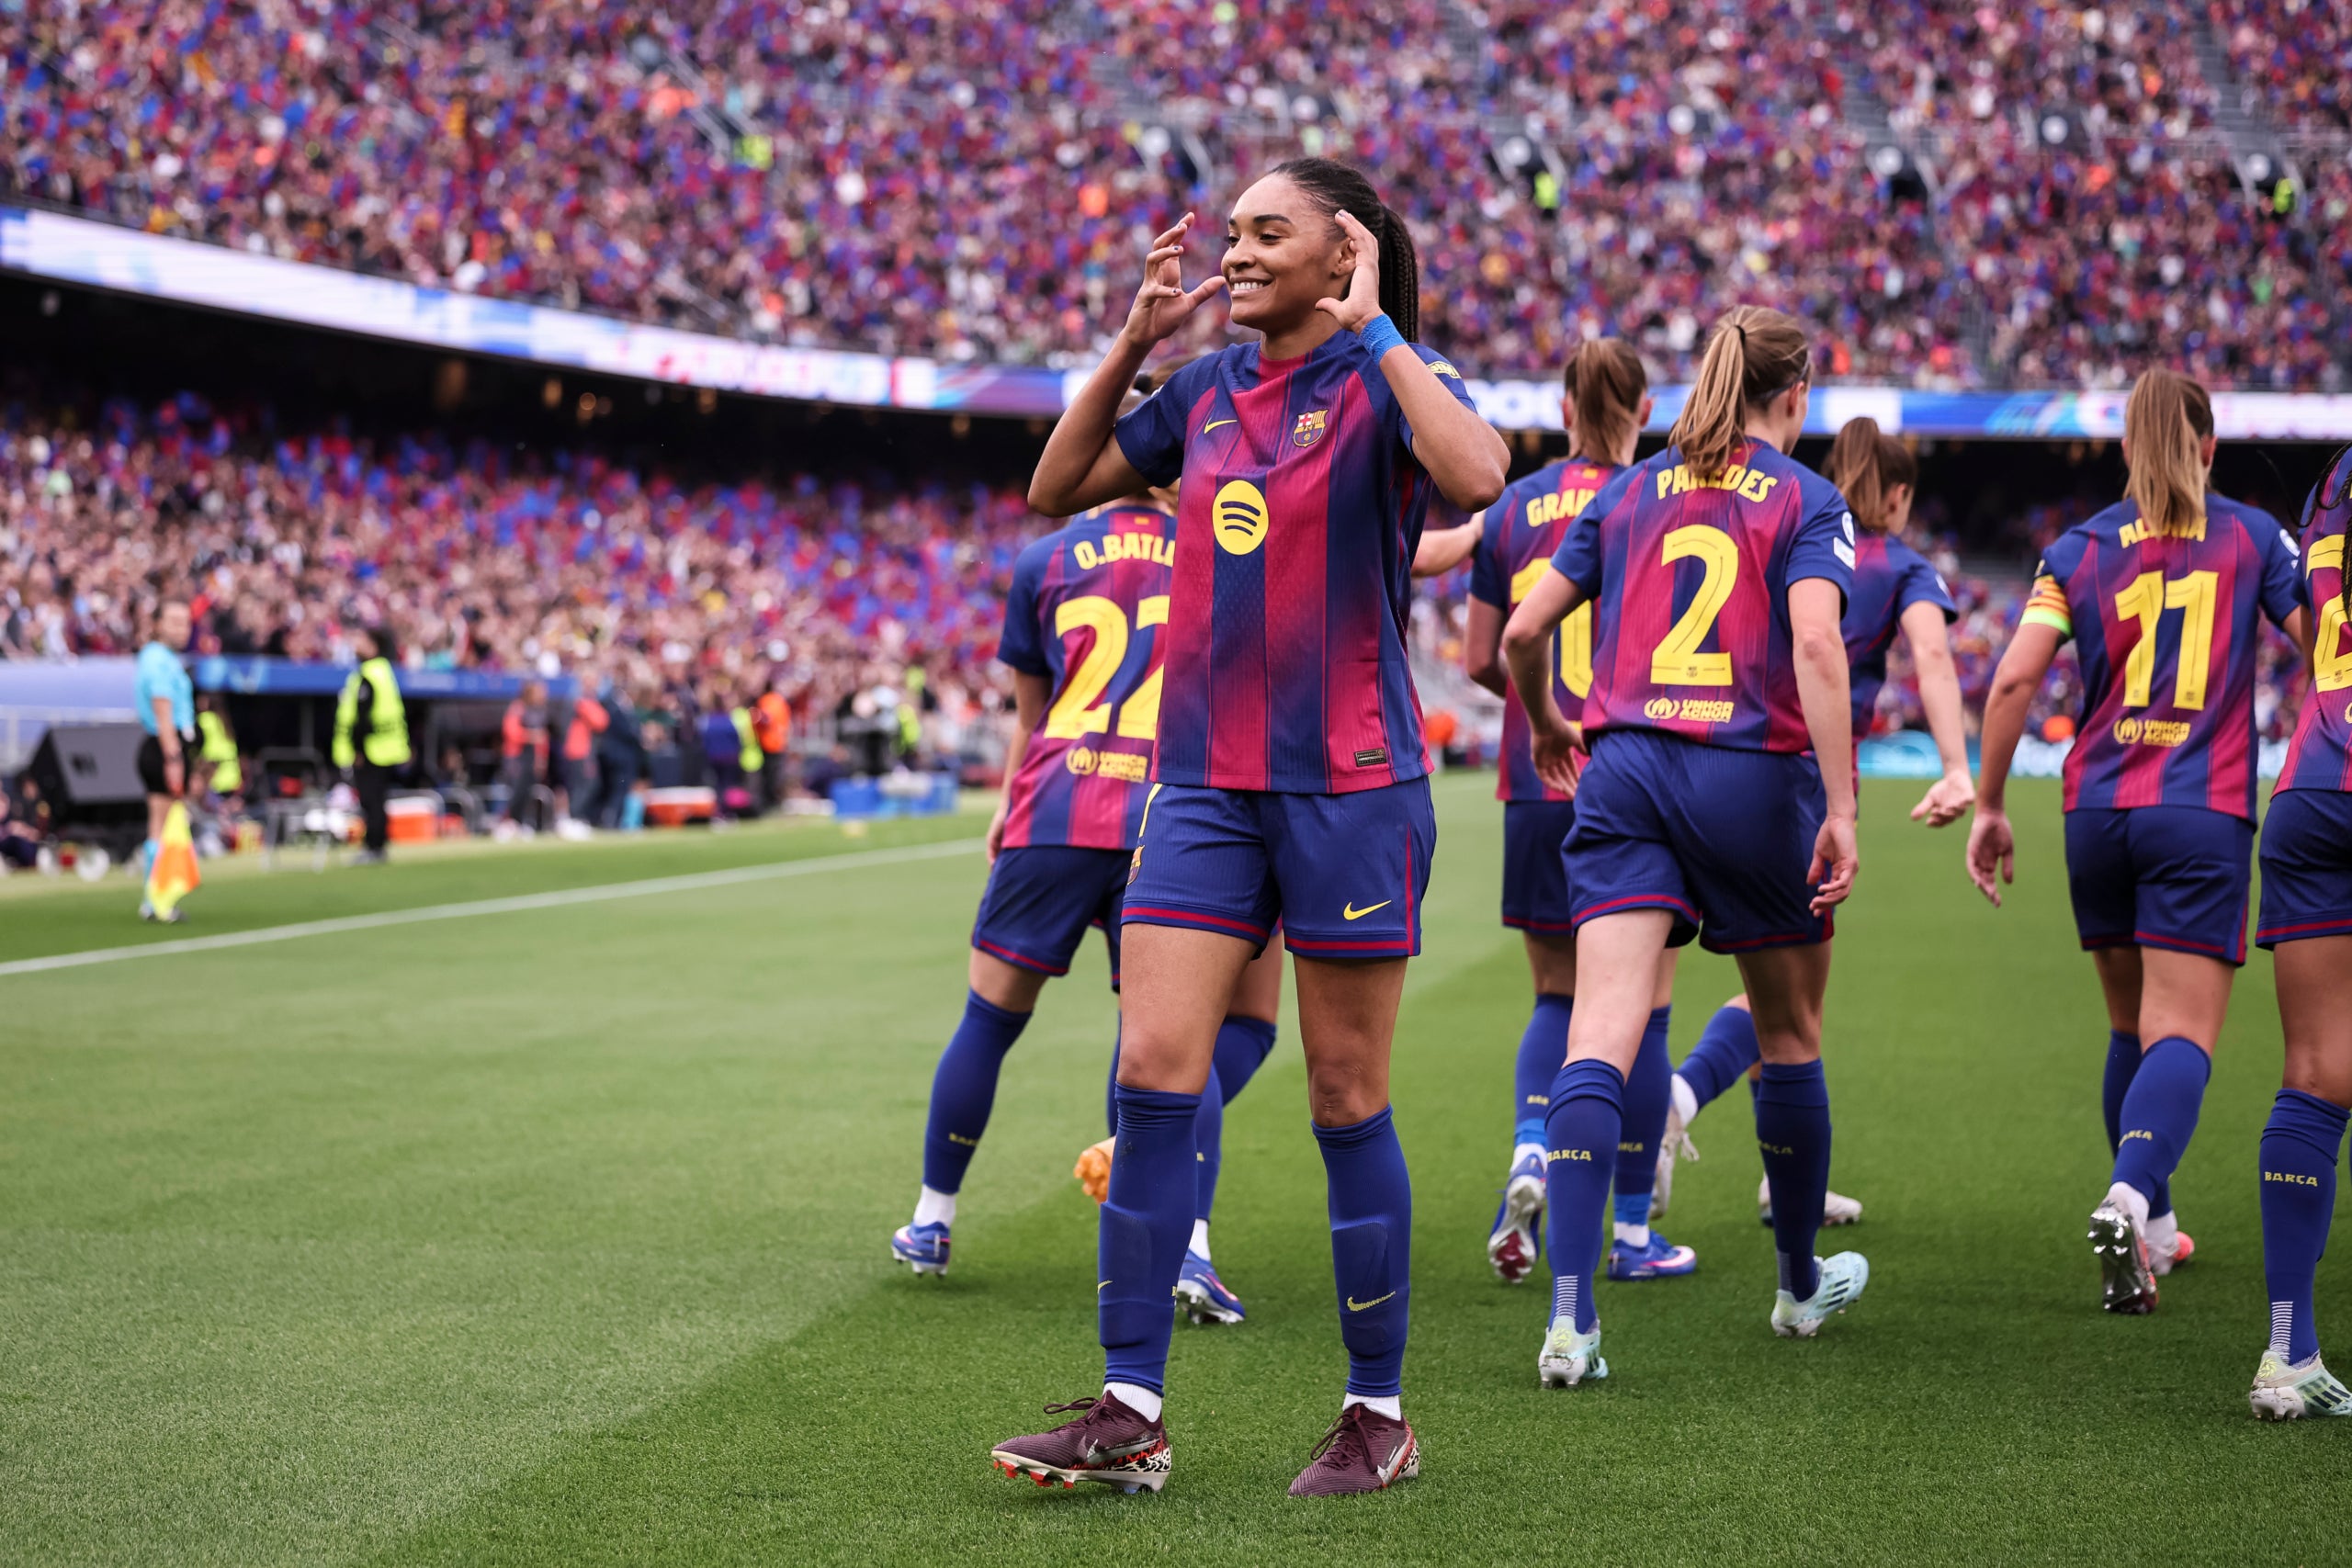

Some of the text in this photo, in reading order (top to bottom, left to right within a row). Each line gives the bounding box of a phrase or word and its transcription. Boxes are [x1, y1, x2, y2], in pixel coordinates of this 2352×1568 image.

[1650, 525, 1738, 686] 2
[2115, 570, 2219, 711] 11
[2265, 1171, 2318, 1187] BARÇA
